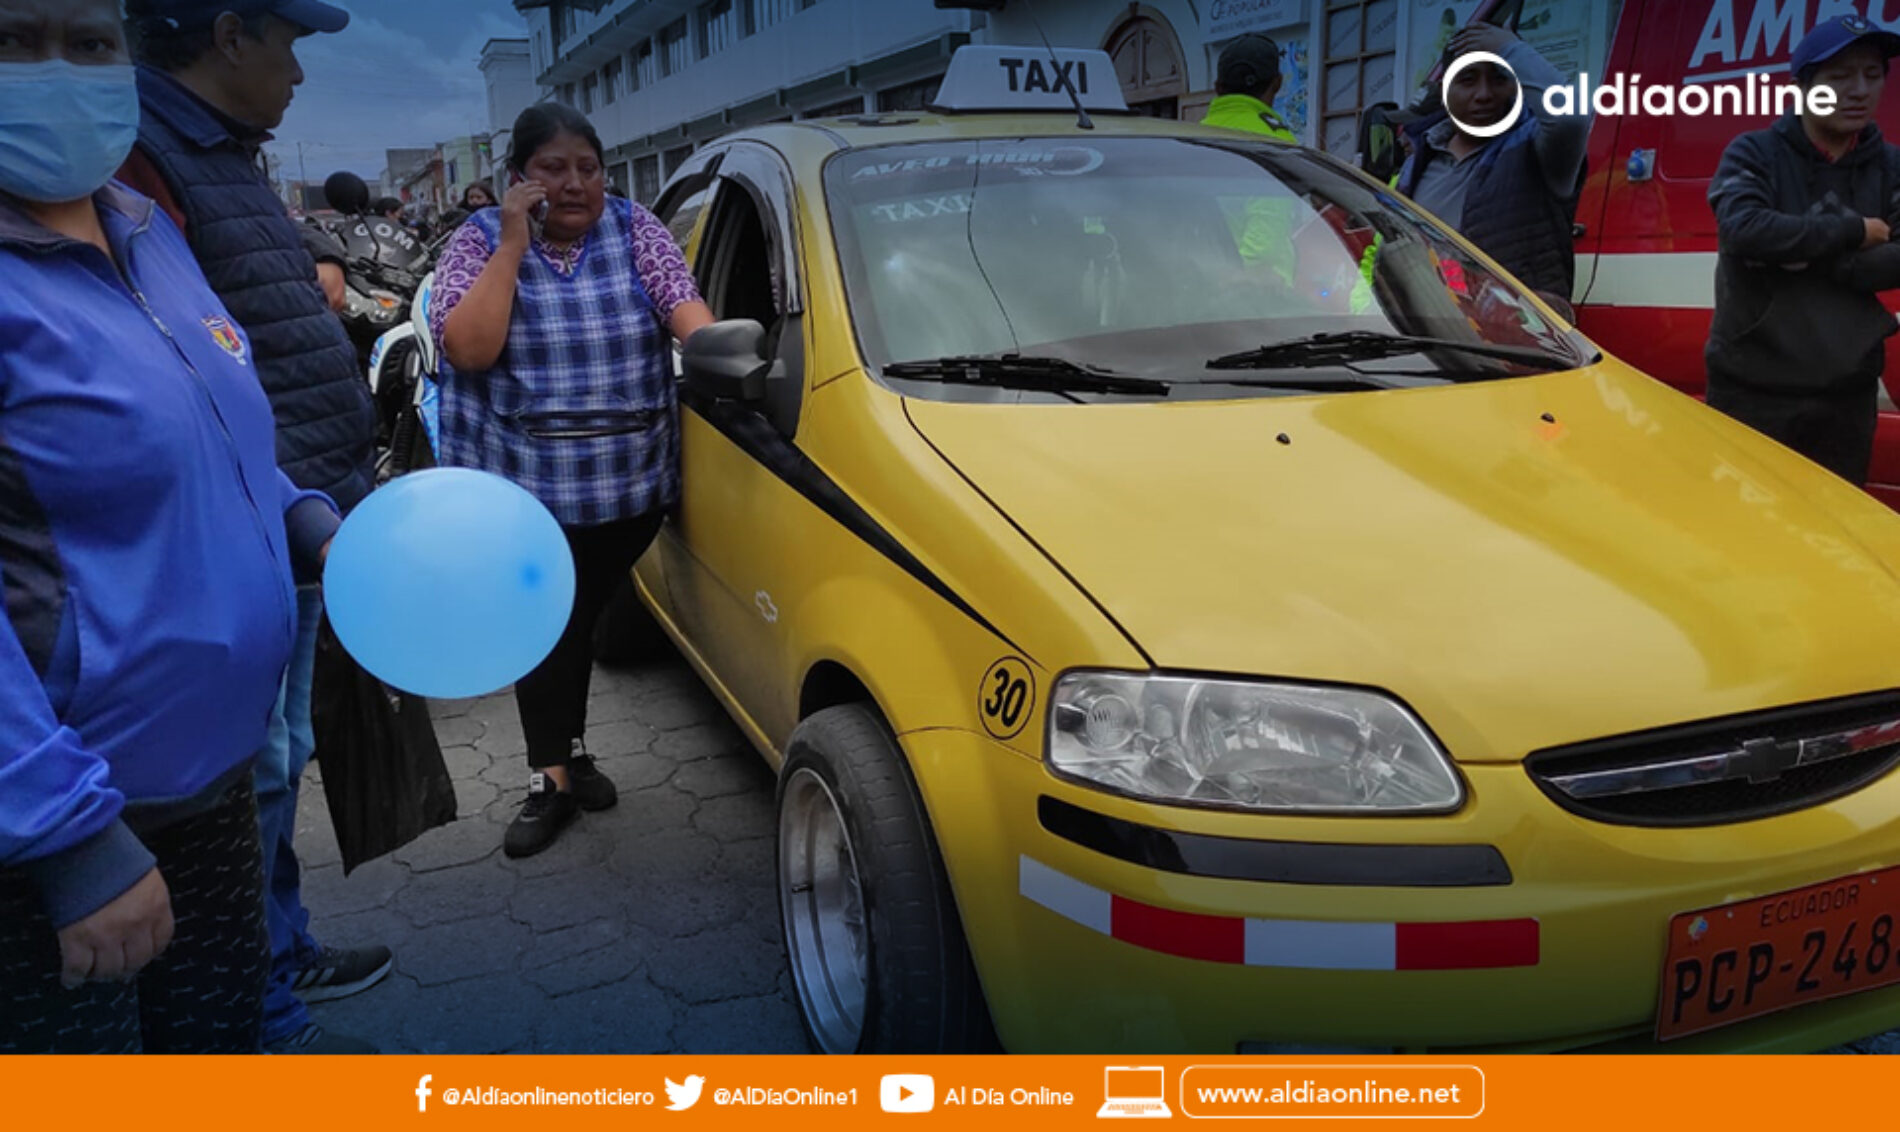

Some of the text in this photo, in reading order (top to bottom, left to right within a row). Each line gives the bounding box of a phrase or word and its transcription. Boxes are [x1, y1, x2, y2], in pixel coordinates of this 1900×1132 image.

[999, 58, 1088, 94] TAXI
[875, 194, 971, 221] TAXI
[985, 668, 1027, 728] 30
[1760, 884, 1860, 928] ECUADOR
[1671, 914, 1900, 1024] PCP-248
